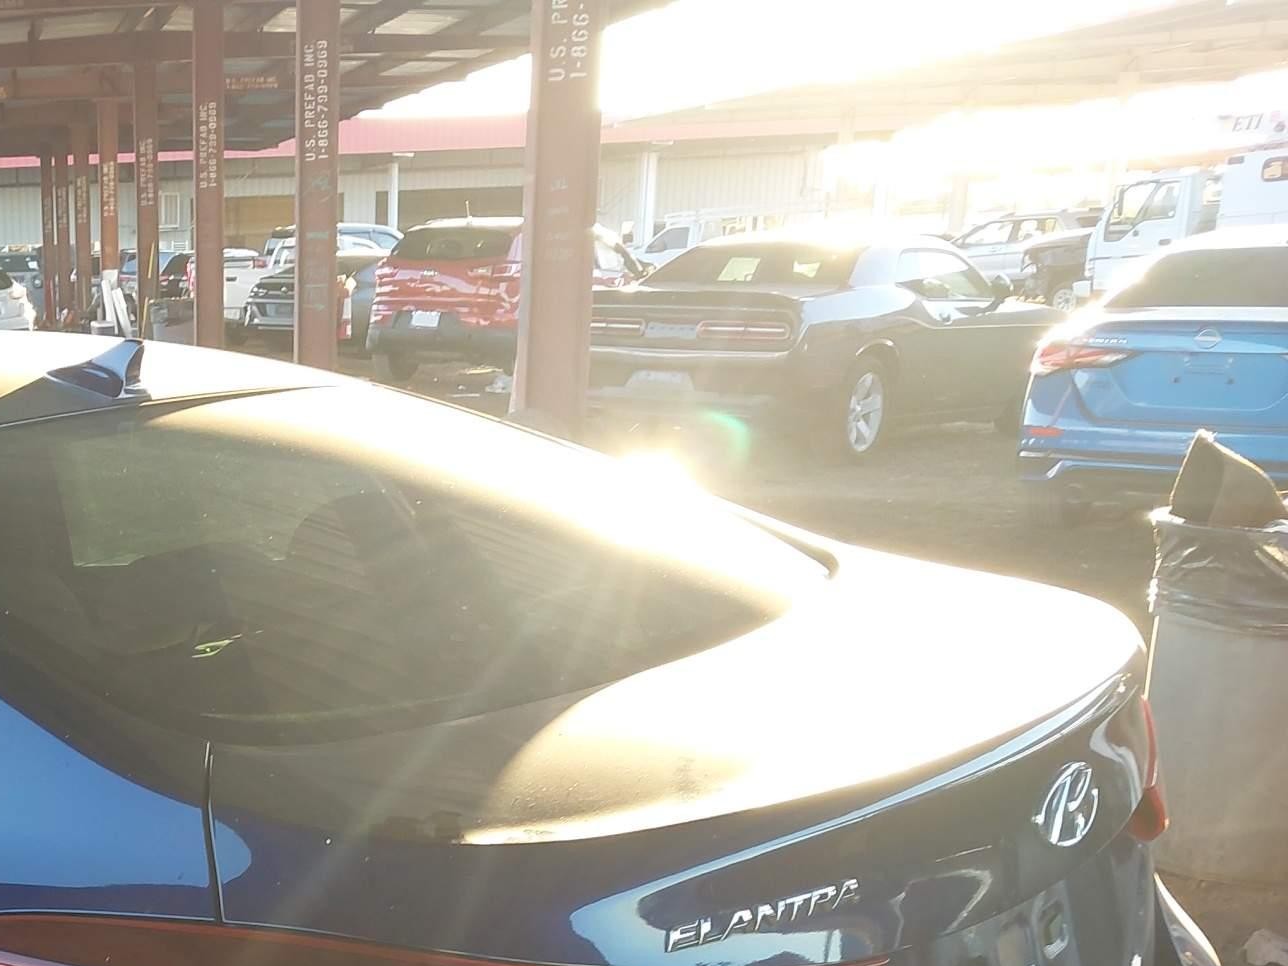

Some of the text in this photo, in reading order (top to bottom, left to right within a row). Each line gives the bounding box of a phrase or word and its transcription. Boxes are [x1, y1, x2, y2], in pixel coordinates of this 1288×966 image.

[548, 38, 568, 82] U.S.
[304, 74, 316, 128] PREFAB
[316, 40, 329, 159] 1-866-799-0969
[305, 135, 317, 161] U.S.
[665, 878, 860, 953] ELANTRA
